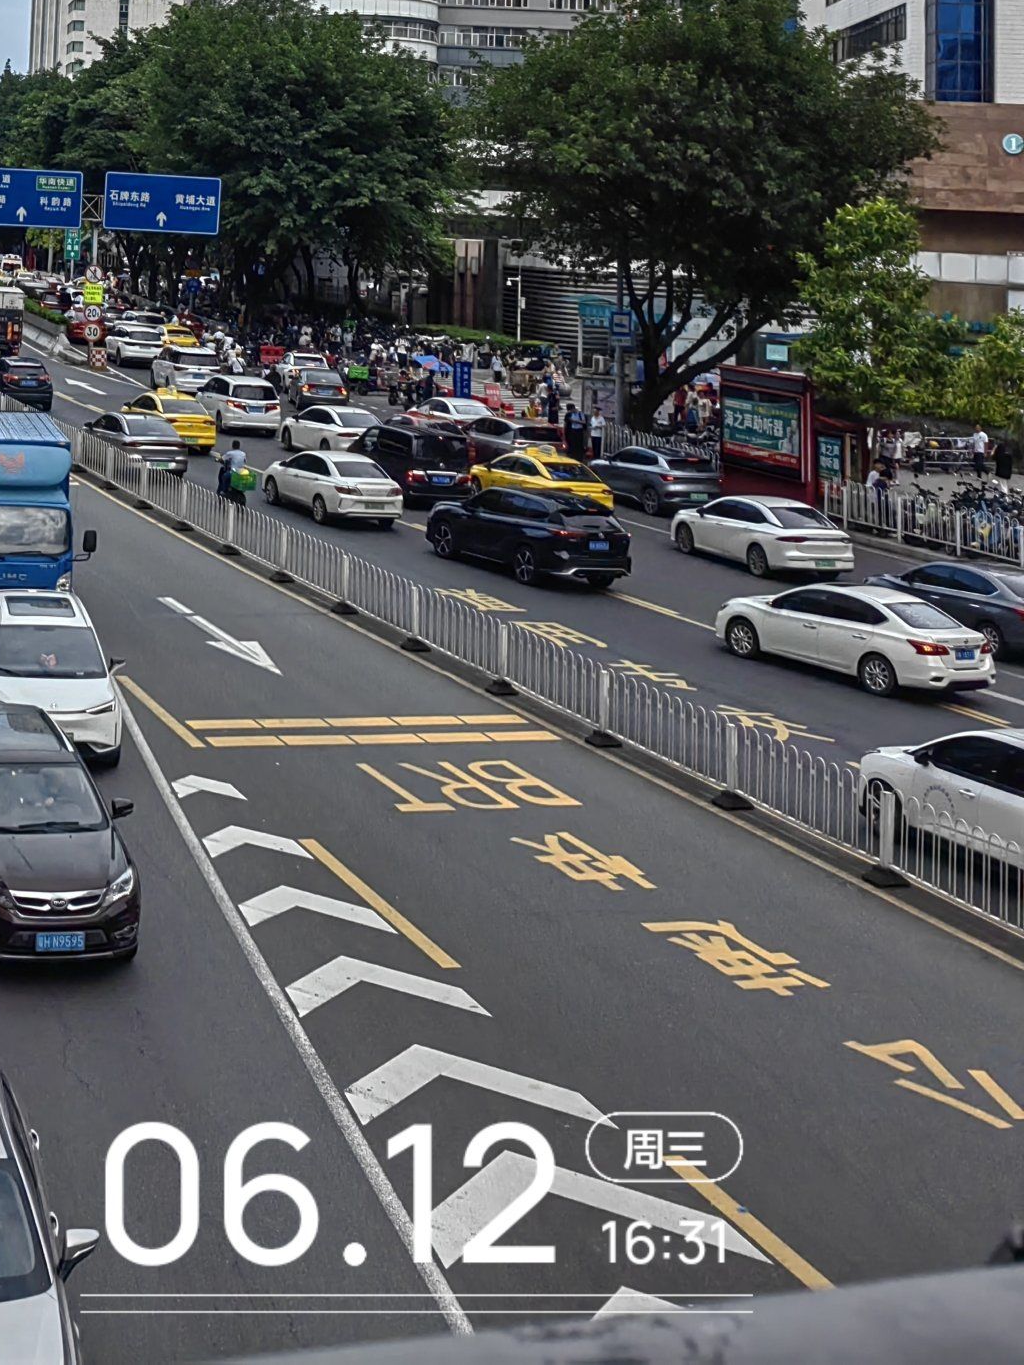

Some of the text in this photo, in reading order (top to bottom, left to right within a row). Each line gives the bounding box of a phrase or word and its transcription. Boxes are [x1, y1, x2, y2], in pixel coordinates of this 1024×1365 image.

[38, 177, 75, 186] 华南快速
[39, 196, 72, 207] 科韵路
[109, 189, 150, 203] 石牌东路
[175, 194, 216, 207] 黄埔大道
[87, 326, 99, 337] 30
[356, 760, 582, 812] BRT
